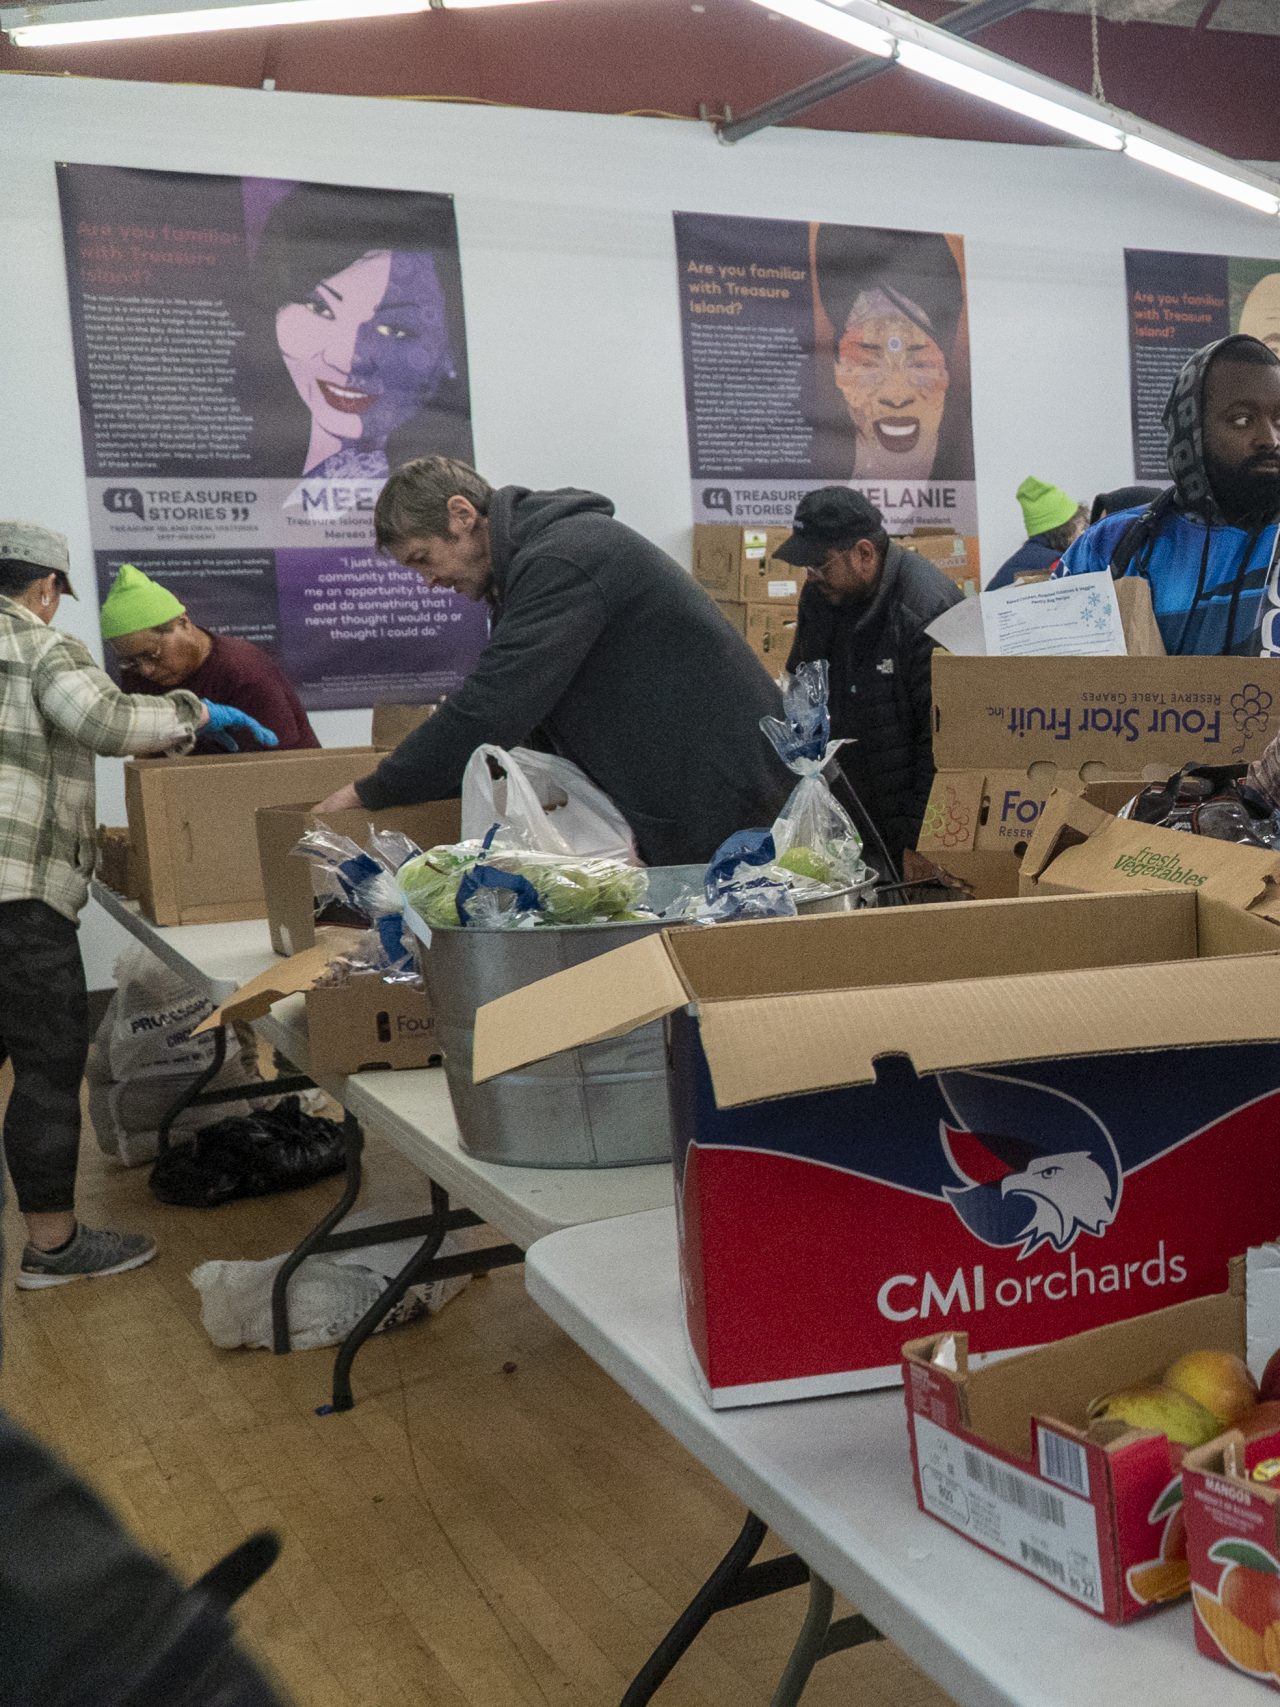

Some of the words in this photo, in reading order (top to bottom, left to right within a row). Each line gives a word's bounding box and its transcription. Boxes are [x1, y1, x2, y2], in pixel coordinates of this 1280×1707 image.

[688, 261, 714, 274] Are
[719, 266, 746, 278] you
[750, 263, 805, 280] familiar
[689, 281, 721, 294] with
[725, 282, 790, 298] Treasure
[1135, 291, 1153, 302] Are
[1159, 295, 1179, 306] you
[1183, 293, 1225, 306] familiar
[690, 301, 743, 314] Island?
[1135, 309, 1160, 320] with
[1164, 309, 1213, 322] Treasure
[1135, 326, 1175, 337] Island?
[146, 491, 257, 503] TREASURED
[860, 488, 956, 508] ELANIE
[150, 507, 226, 521] STORIES
[736, 505, 792, 516] STORIES
[286, 517, 336, 525] Treasure
[351, 556, 372, 569] just
[318, 573, 384, 583] community
[388, 572, 413, 580] that
[305, 588, 322, 597] me
[327, 588, 341, 596] an
[345, 586, 413, 597] opportunity
[313, 601, 336, 611] and
[340, 601, 354, 610] do
[358, 599, 418, 611] something
[422, 598, 446, 608] that
[305, 617, 337, 625] never
[341, 615, 388, 626] thought
[398, 613, 430, 622] would
[434, 613, 447, 622] do
[451, 613, 462, 621] or
[331, 629, 377, 641] thought
[388, 628, 418, 637] could
[1082, 692, 1126, 704] GRAPES
[1132, 692, 1166, 704] TABLE
[1170, 693, 1221, 705] RESERVE
[1079, 708, 1140, 742] Star
[1148, 709, 1221, 743] Four
[1134, 847, 1181, 868] fresh
[877, 1266, 984, 1322] CMI
[996, 1240, 1187, 1306] orchards
